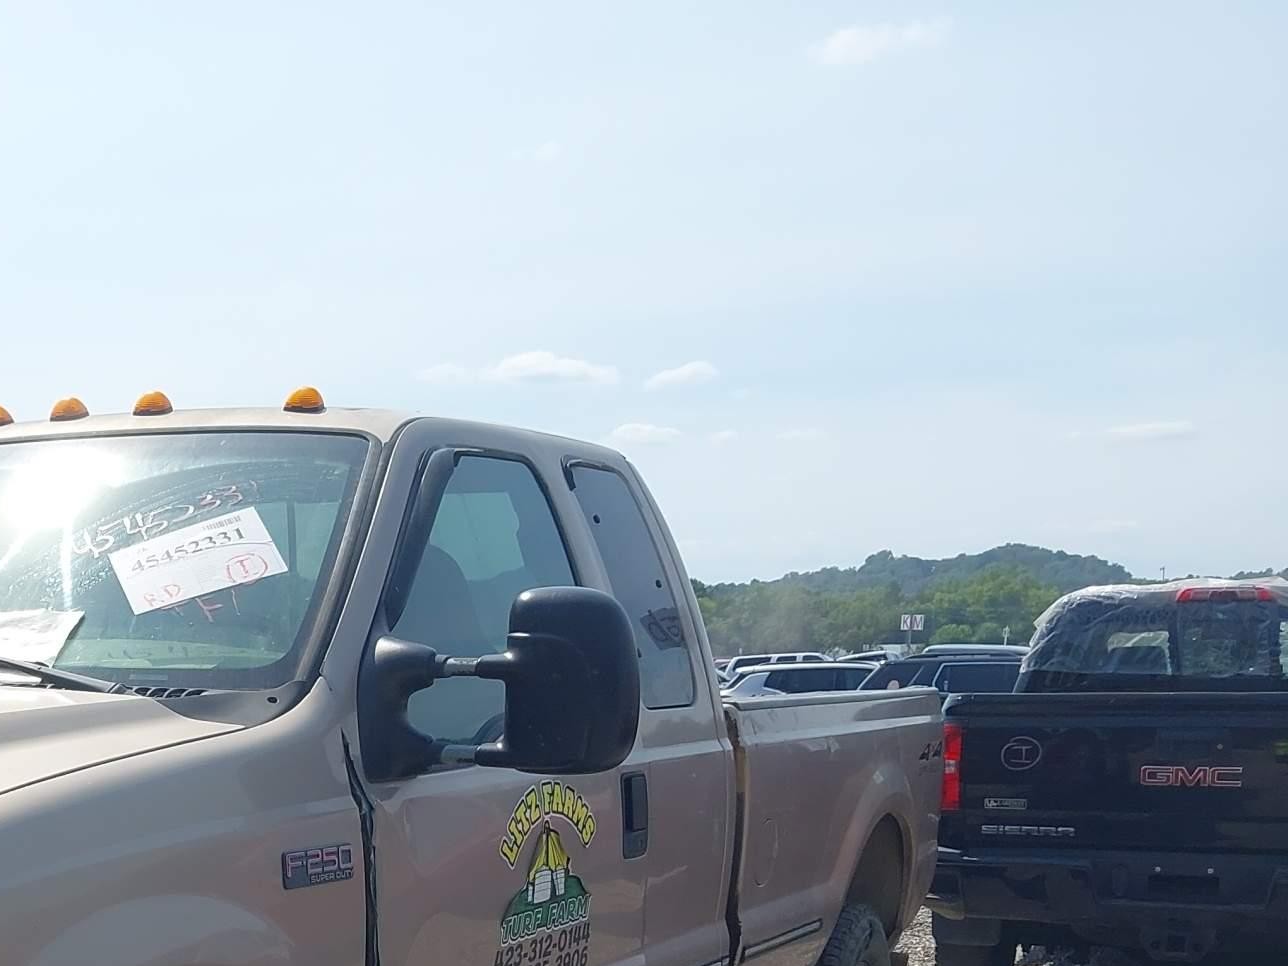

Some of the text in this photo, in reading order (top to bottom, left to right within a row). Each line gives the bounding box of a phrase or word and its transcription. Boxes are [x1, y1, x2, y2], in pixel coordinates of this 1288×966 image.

[131, 526, 245, 573] 45452331
[1140, 765, 1243, 787] GMC
[500, 781, 596, 868] LITZ FARMS
[311, 872, 335, 883] SUPER
[501, 894, 592, 946] TURF FARM
